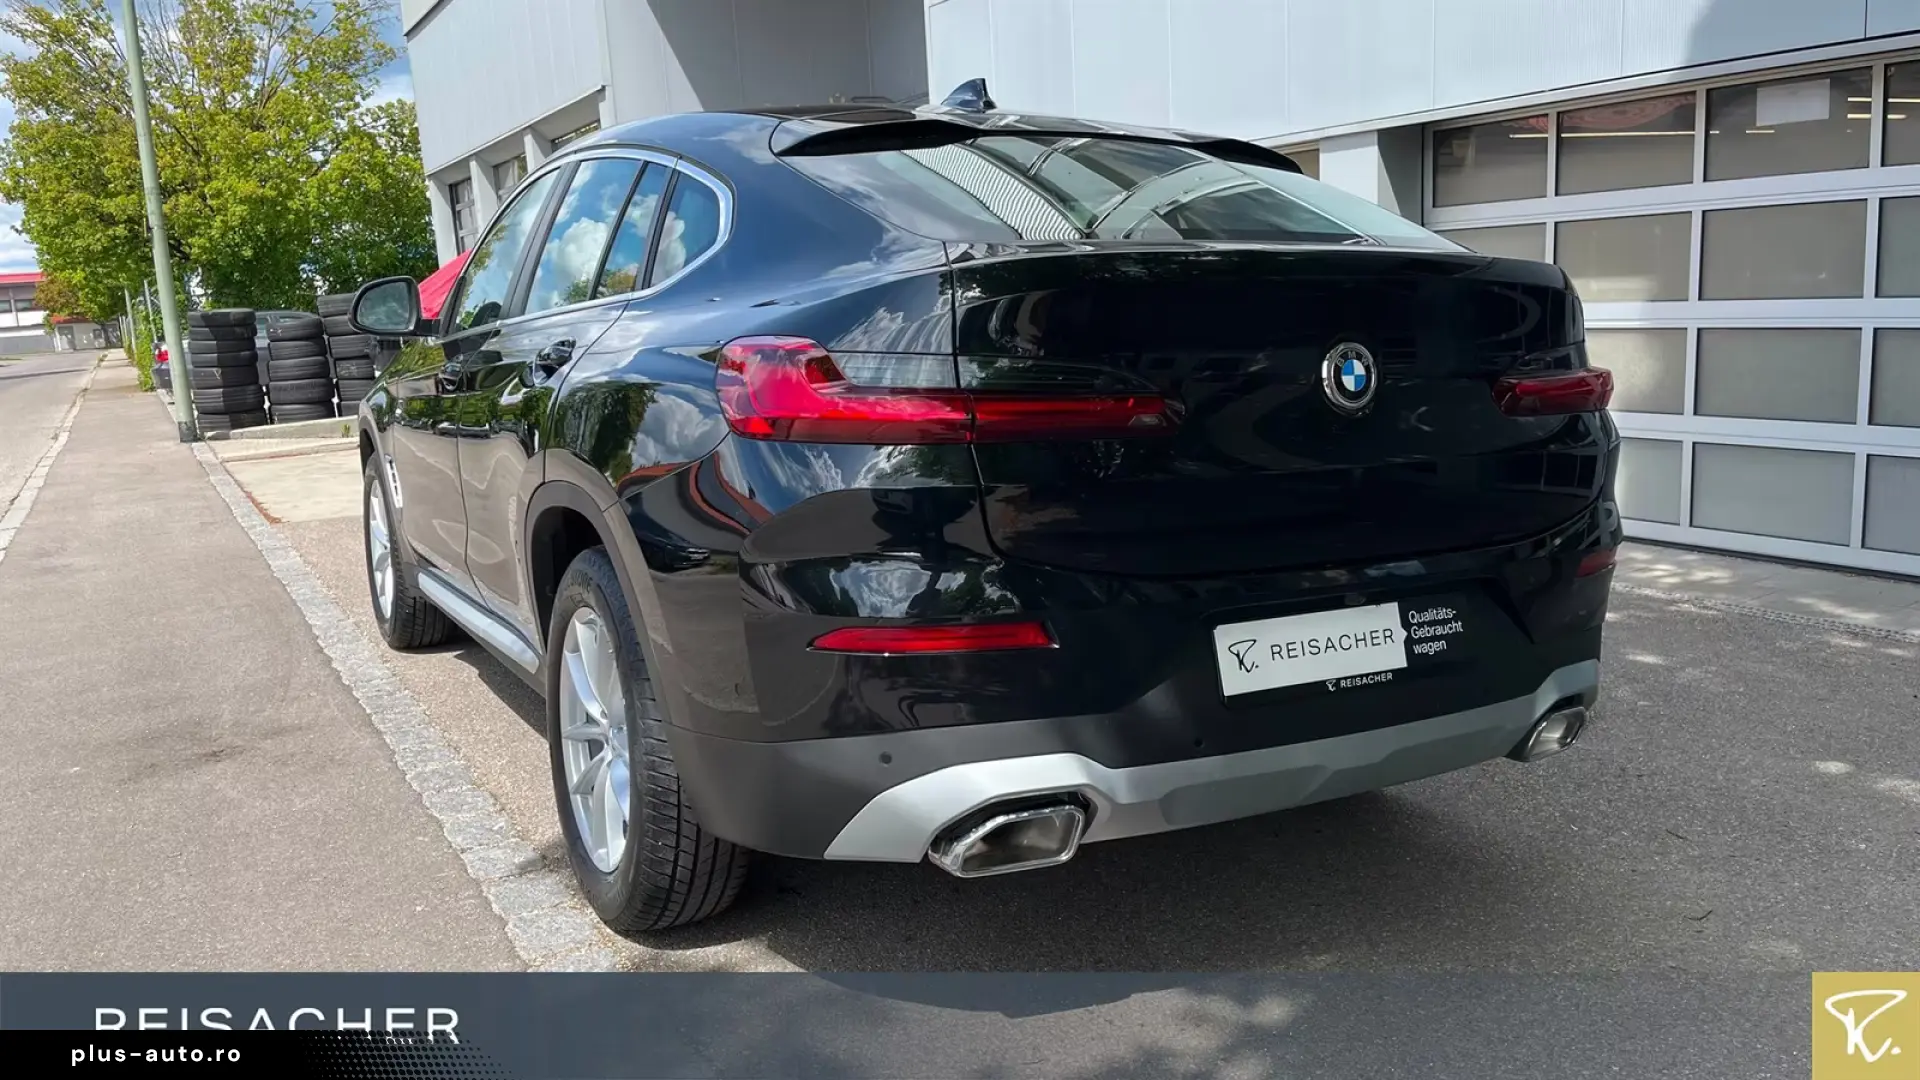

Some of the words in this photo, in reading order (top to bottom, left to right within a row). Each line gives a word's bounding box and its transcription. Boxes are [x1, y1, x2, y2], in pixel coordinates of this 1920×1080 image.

[1408, 606, 1457, 624] Qualitäts-
[1410, 620, 1463, 639] Gebraucht
[1270, 628, 1395, 661] REISACHER
[1413, 640, 1447, 655] wagen
[1340, 672, 1393, 688] REISACHER
